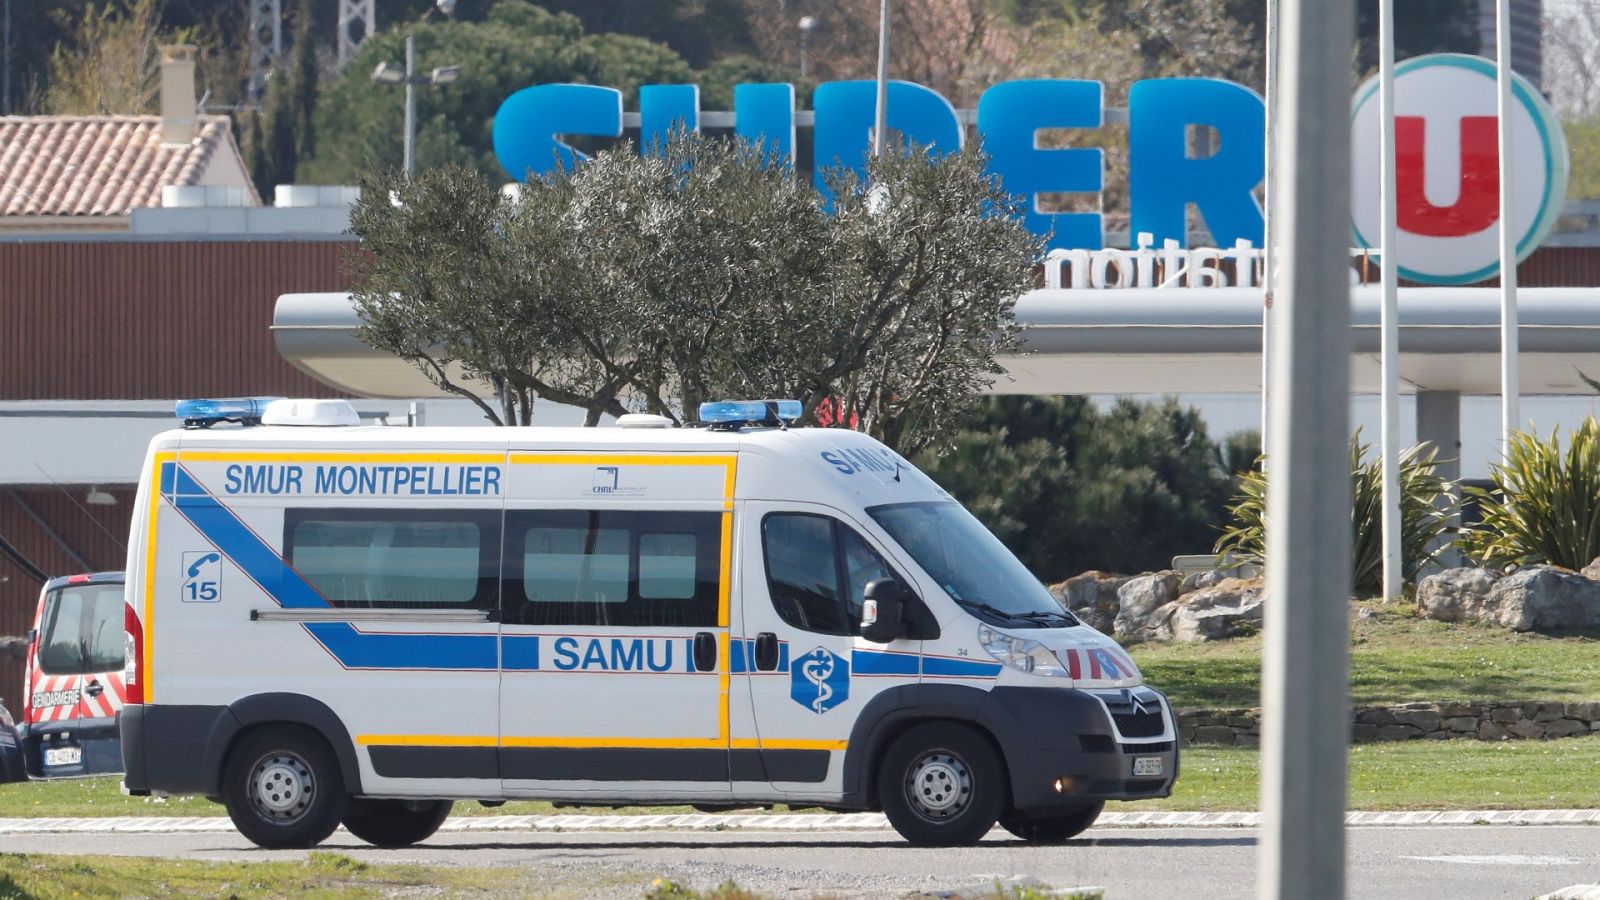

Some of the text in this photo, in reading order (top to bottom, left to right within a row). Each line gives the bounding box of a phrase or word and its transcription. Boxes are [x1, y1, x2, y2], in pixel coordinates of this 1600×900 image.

[1394, 115, 1500, 237] U
[224, 464, 501, 496] SMUR MONTPELLIER
[186, 581, 218, 601] 15
[553, 637, 673, 672] SAMU
[957, 648, 968, 656] 34
[32, 689, 80, 708] GENDARMERIE
